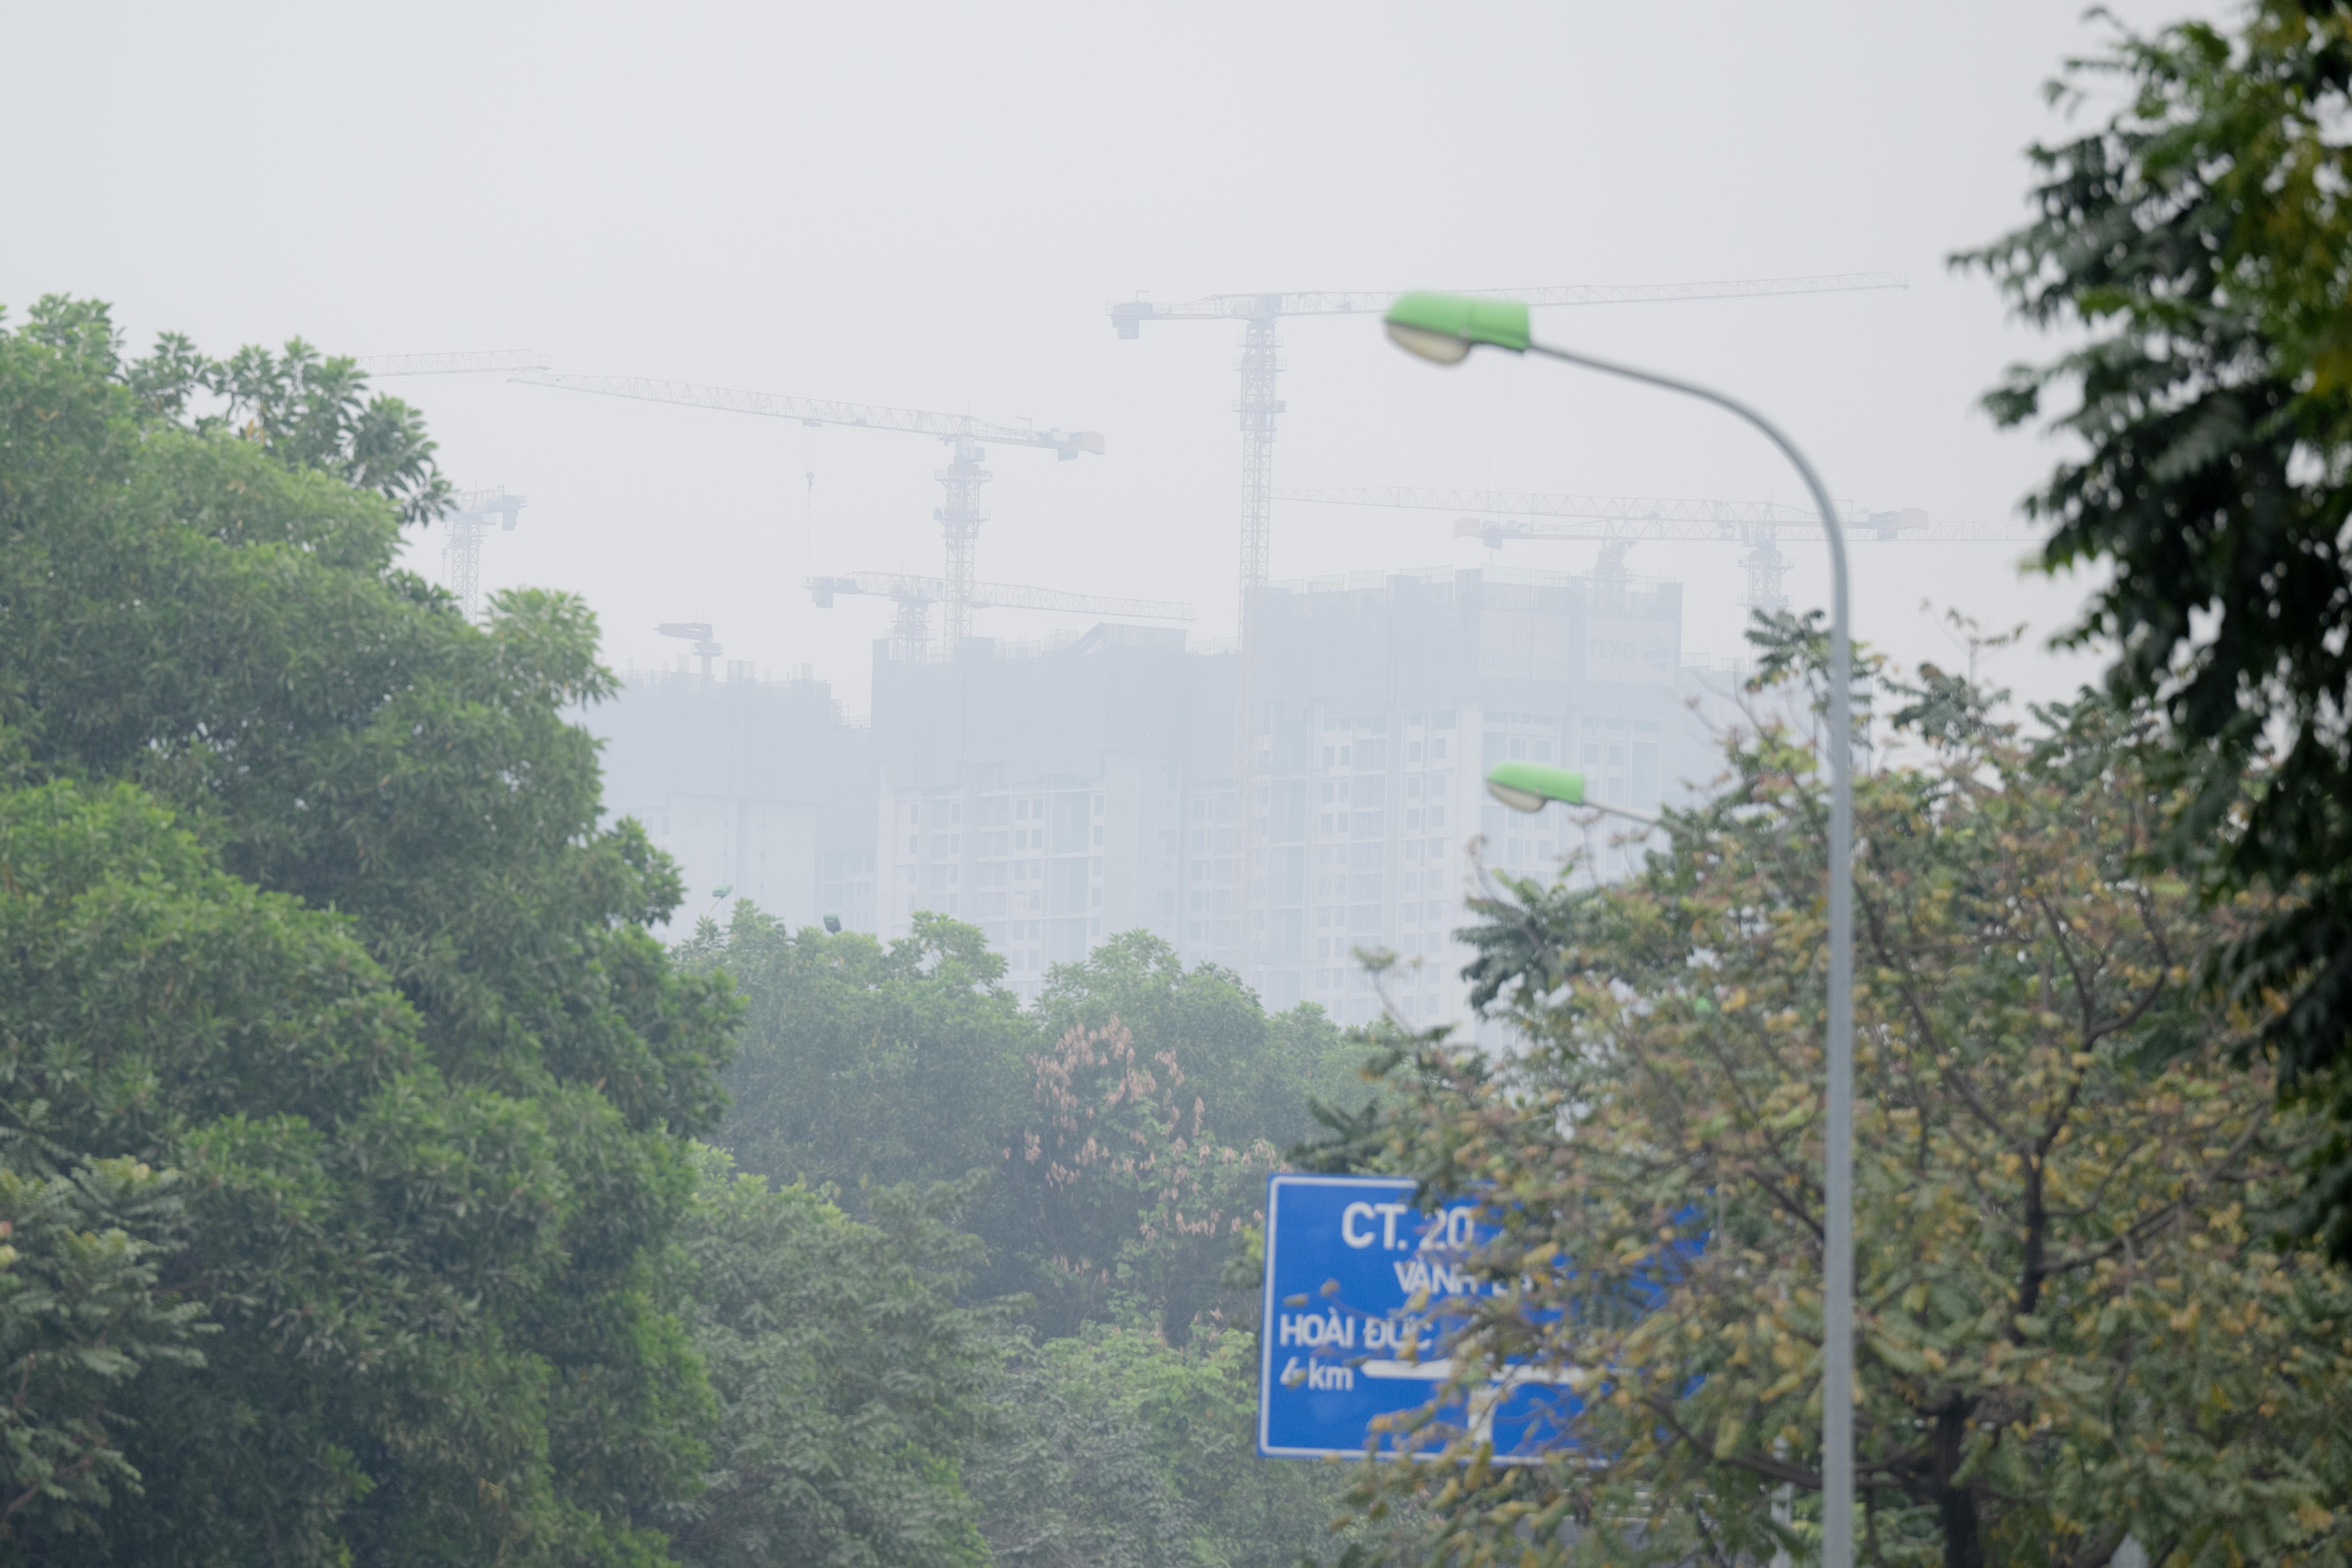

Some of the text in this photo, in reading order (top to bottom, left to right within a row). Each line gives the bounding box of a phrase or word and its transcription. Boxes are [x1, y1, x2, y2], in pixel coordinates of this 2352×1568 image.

[1481, 653, 1564, 671] NEWTECONS
[1588, 639, 1636, 661] TEXO
[1016, 900, 1022, 910] 30
[1341, 1201, 1475, 1251] CT. 20
[1279, 1306, 1355, 1348] HOÀI
[1308, 1357, 1354, 1391] km
